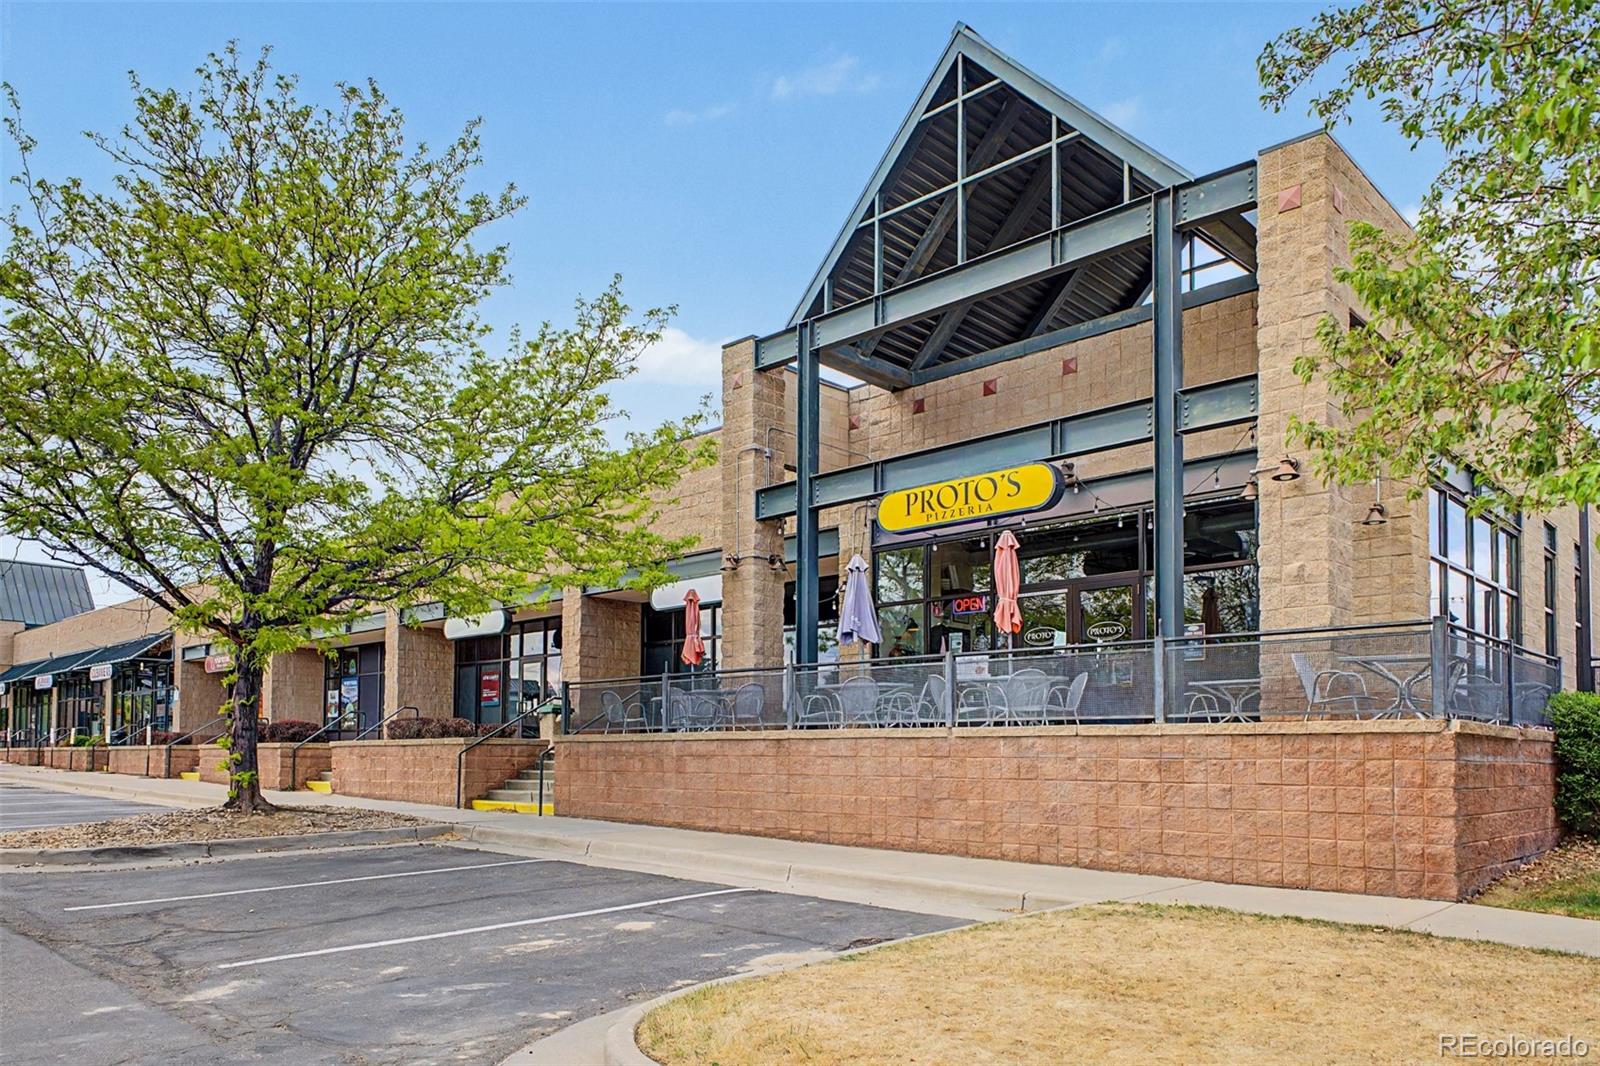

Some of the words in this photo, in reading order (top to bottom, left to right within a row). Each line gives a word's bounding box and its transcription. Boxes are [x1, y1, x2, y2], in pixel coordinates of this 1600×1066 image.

[905, 471, 1021, 517] PROTO'S
[926, 503, 993, 522] PIZZERIA
[955, 597, 983, 612] OPEN
[1027, 631, 1055, 641] PROTO'
